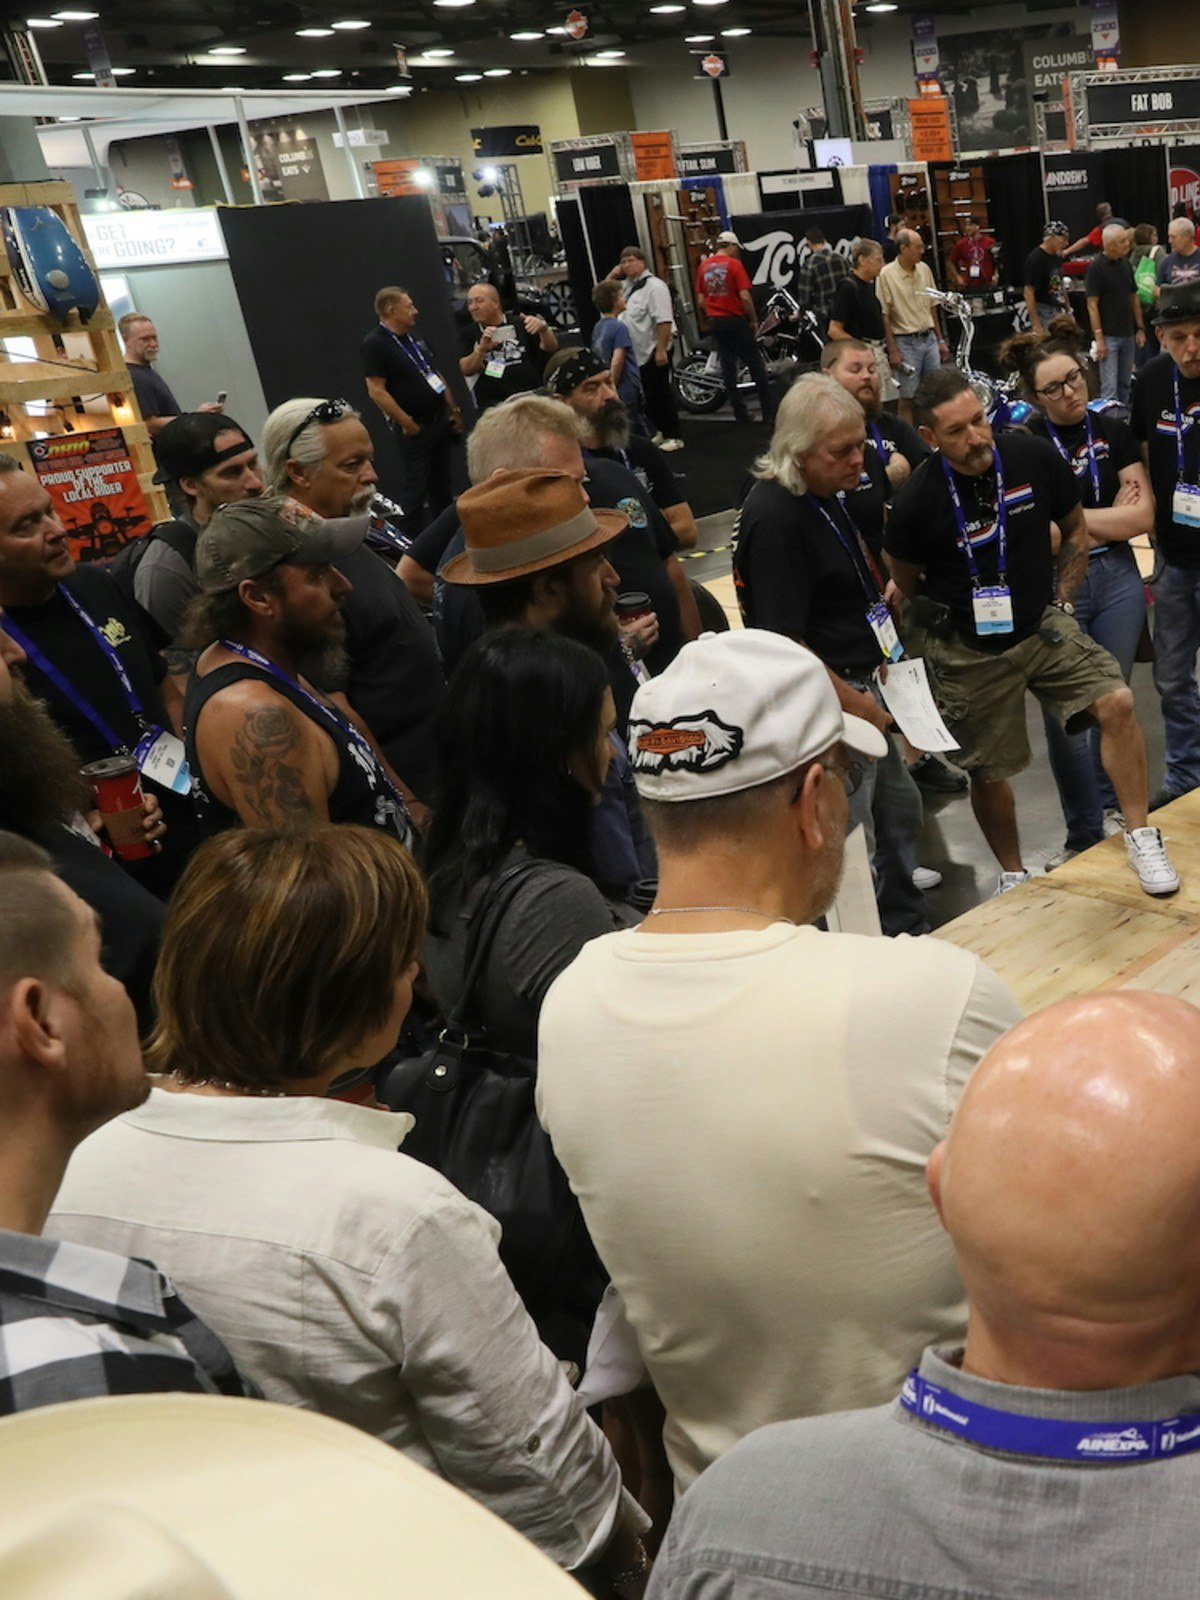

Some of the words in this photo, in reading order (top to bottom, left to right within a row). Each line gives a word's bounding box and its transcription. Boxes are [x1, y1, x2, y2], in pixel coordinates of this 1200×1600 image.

[1034, 72, 1066, 87] EATS
[1131, 94, 1149, 112] FAT
[1151, 92, 1173, 111] BOB
[95, 224, 127, 241] GET
[114, 238, 175, 258] GOING?
[41, 469, 75, 486] PROUD
[76, 460, 132, 480] SUPPORTER
[73, 479, 85, 491] OF
[88, 475, 104, 489] THE
[63, 489, 94, 503] LOCAL
[94, 482, 123, 498] RIDER
